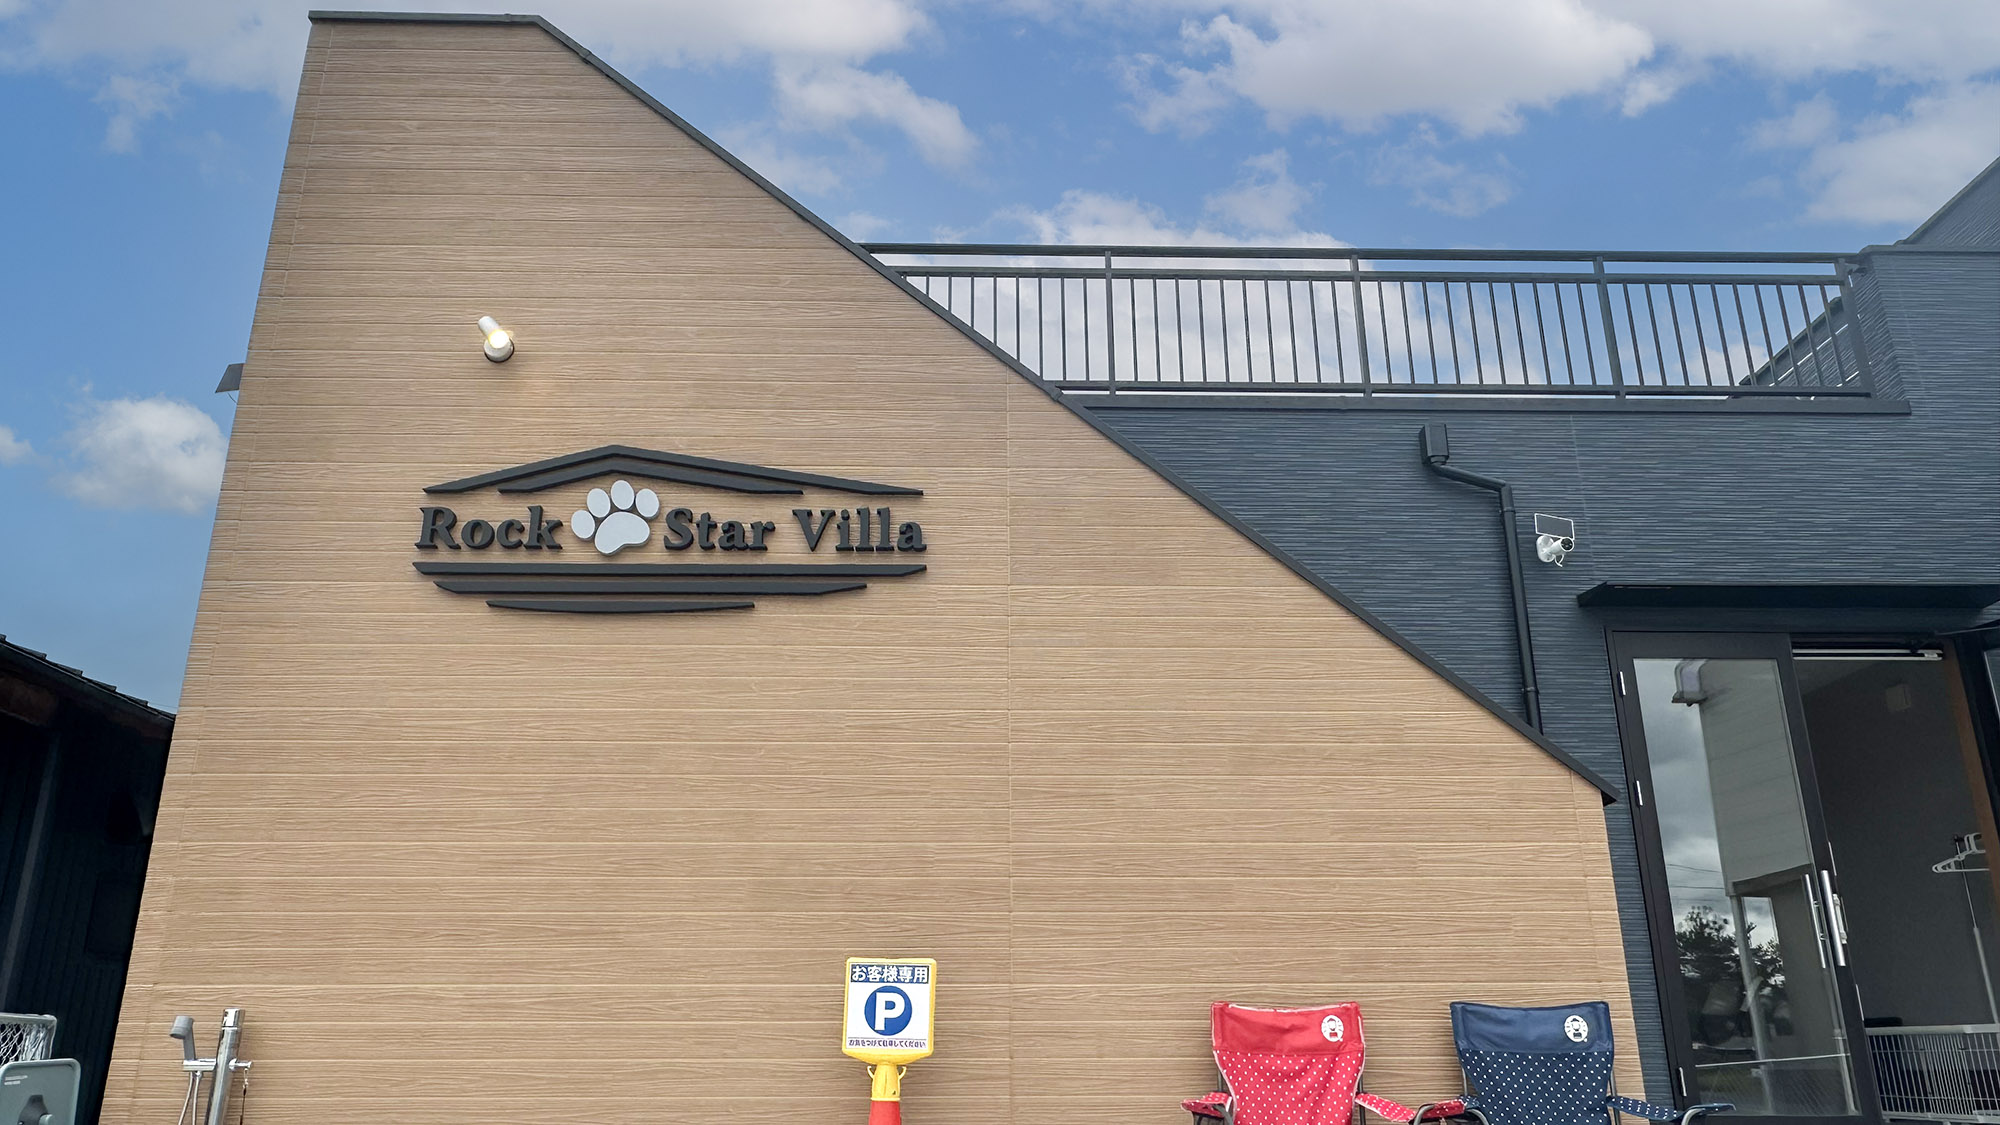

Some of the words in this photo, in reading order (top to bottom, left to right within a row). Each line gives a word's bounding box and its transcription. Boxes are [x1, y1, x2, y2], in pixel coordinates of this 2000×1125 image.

[415, 505, 563, 550] Rock
[663, 507, 775, 552] Star
[793, 507, 927, 552] Villa
[851, 965, 928, 983] お客様専用
[874, 992, 906, 1031] P
